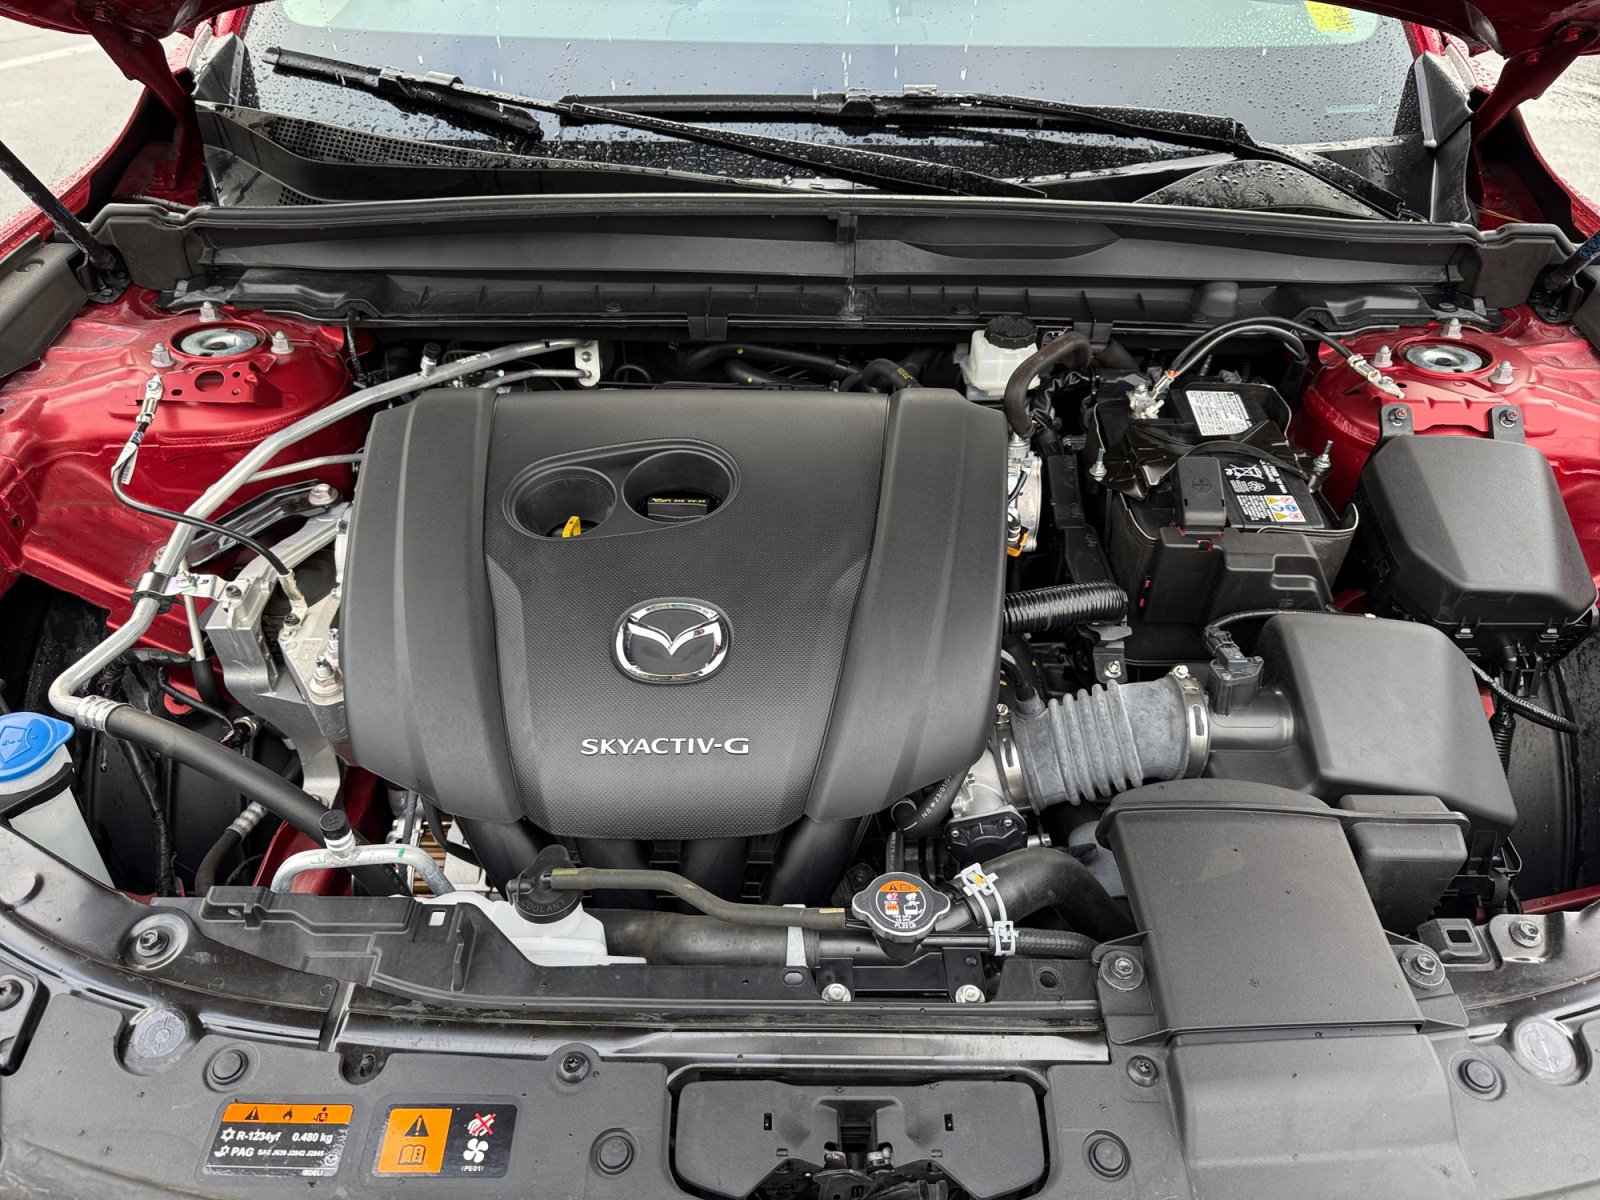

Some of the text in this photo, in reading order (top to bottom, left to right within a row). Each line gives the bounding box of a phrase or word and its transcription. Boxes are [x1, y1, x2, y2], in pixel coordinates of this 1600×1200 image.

[580, 738, 750, 755] SKYACTIV-G
[521, 898, 568, 913] COOLANT
[236, 1131, 334, 1144] R-1234yf 0.480 kg
[230, 1146, 255, 1157] PAG
